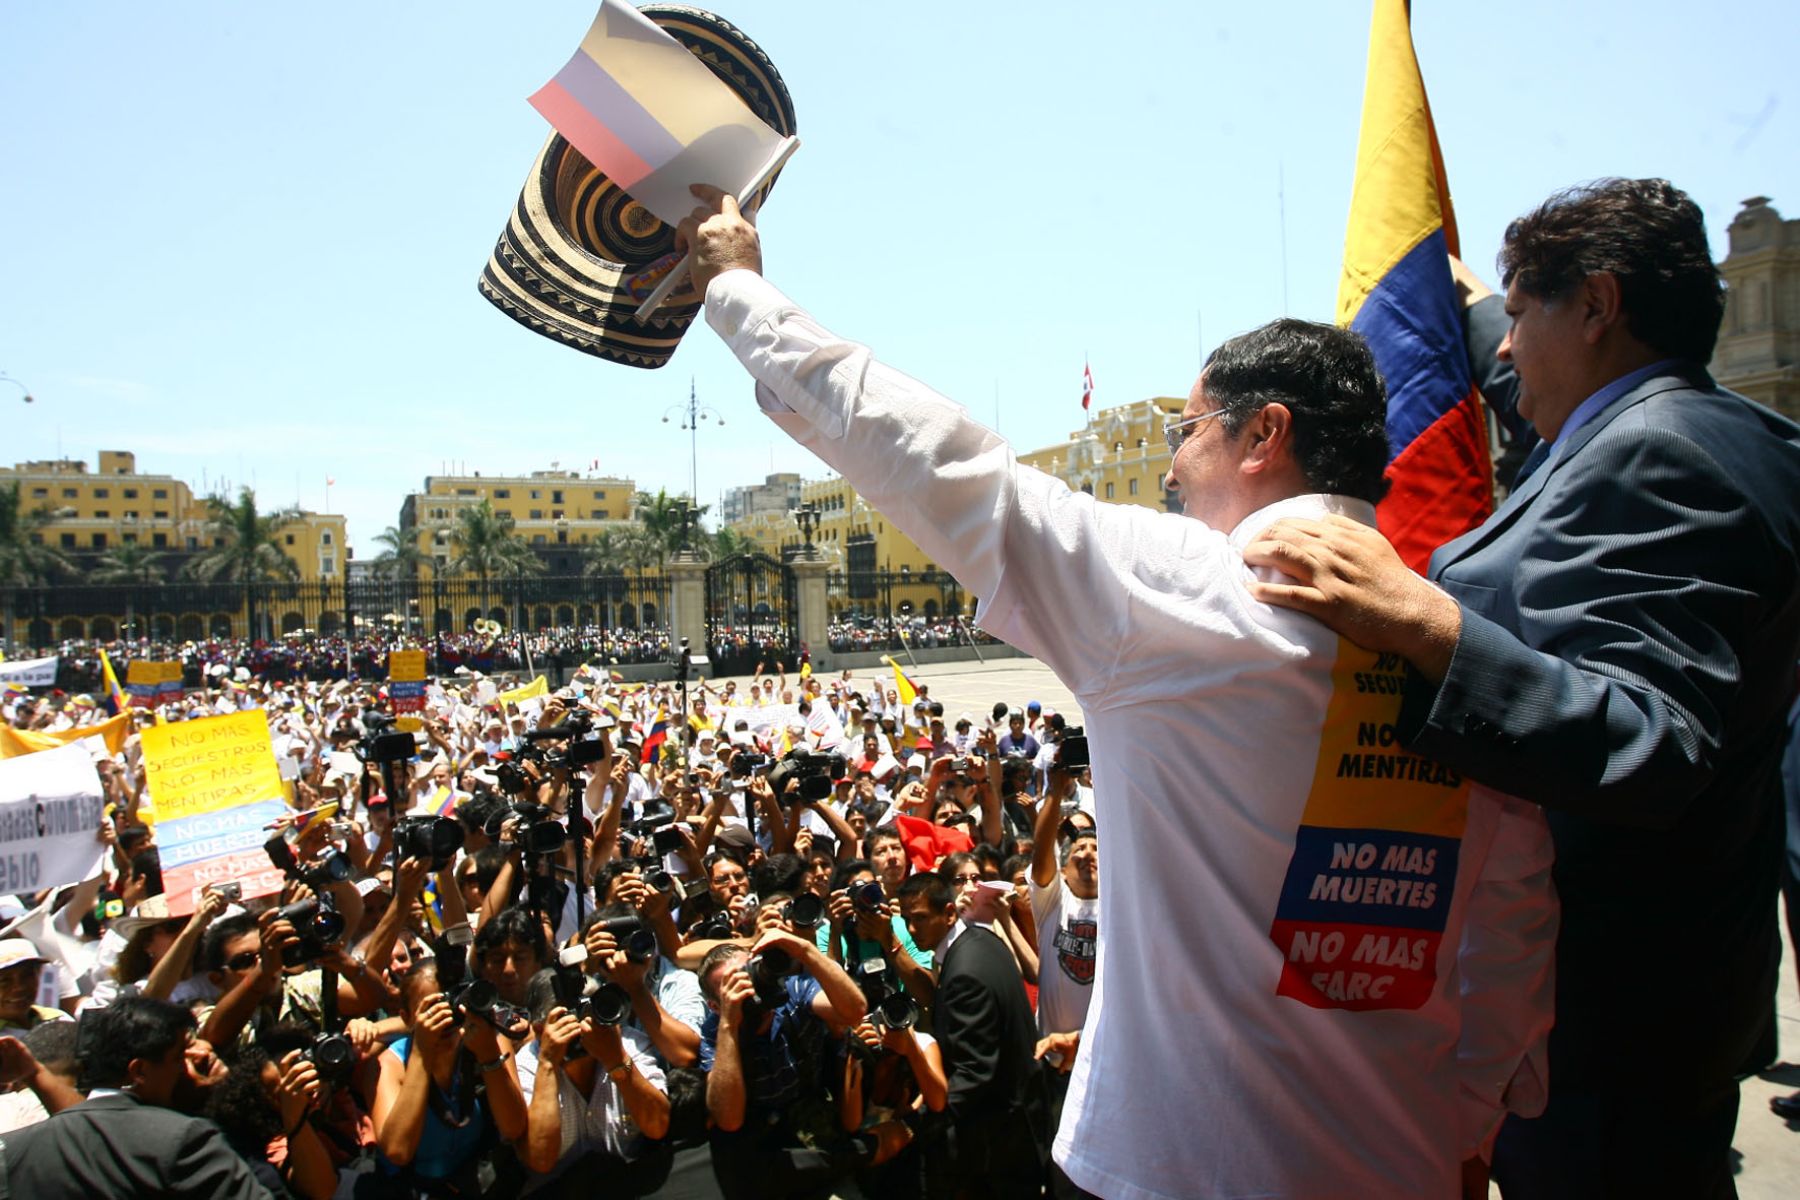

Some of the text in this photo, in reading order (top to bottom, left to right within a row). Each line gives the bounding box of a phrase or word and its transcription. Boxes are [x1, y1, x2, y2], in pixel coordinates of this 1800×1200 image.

[171, 723, 251, 748] NO MAS
[1357, 722, 1395, 747] NO
[149, 742, 267, 773] SECUESTROS
[1336, 754, 1461, 789] MENTIRAS
[159, 762, 253, 792] NO MAS
[156, 783, 257, 813] MENTIRAS
[175, 809, 262, 840] NO MAS
[193, 854, 271, 883] NO MAS
[1330, 842, 1438, 876] NO MAS
[1309, 874, 1438, 909] MUERTES
[1289, 931, 1428, 971] NO MAS
[1311, 971, 1395, 1001] FARC
